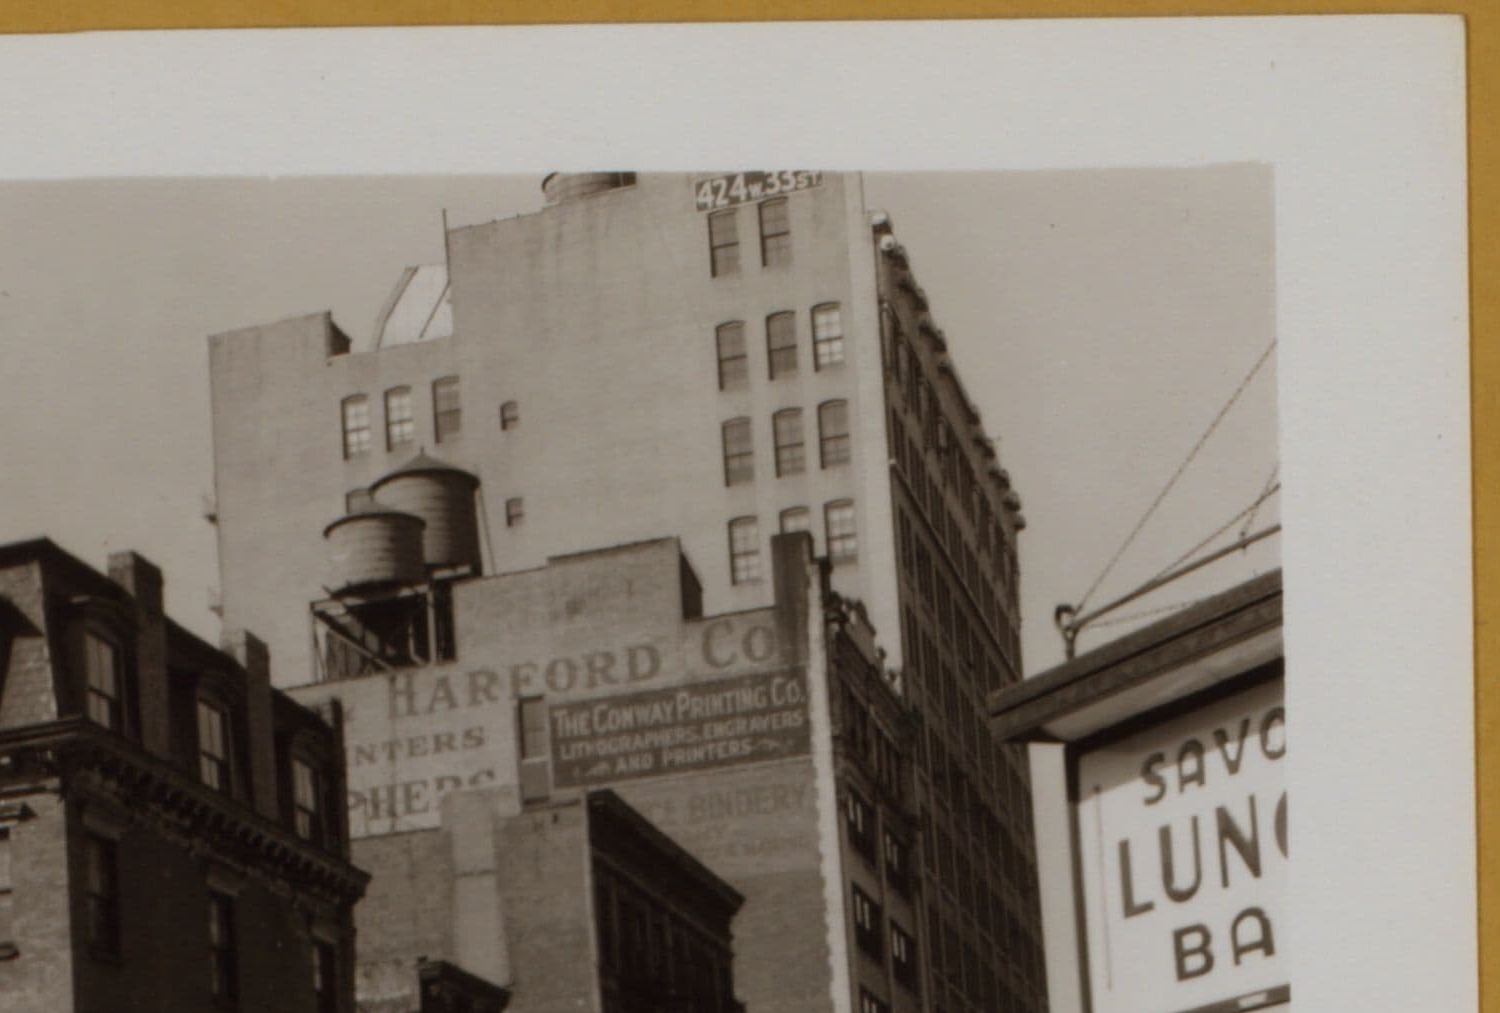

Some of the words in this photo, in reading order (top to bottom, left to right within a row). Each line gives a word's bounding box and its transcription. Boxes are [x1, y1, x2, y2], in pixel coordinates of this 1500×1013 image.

[697, 173, 748, 210] 424
[387, 643, 662, 719] HARFORD
[554, 707, 591, 737] THE
[592, 702, 675, 733] CONWAY
[675, 685, 767, 720] PRINTING
[703, 709, 804, 740] ENGRAVERS
[615, 751, 653, 774] AND
[662, 738, 752, 767] PRINTERS
